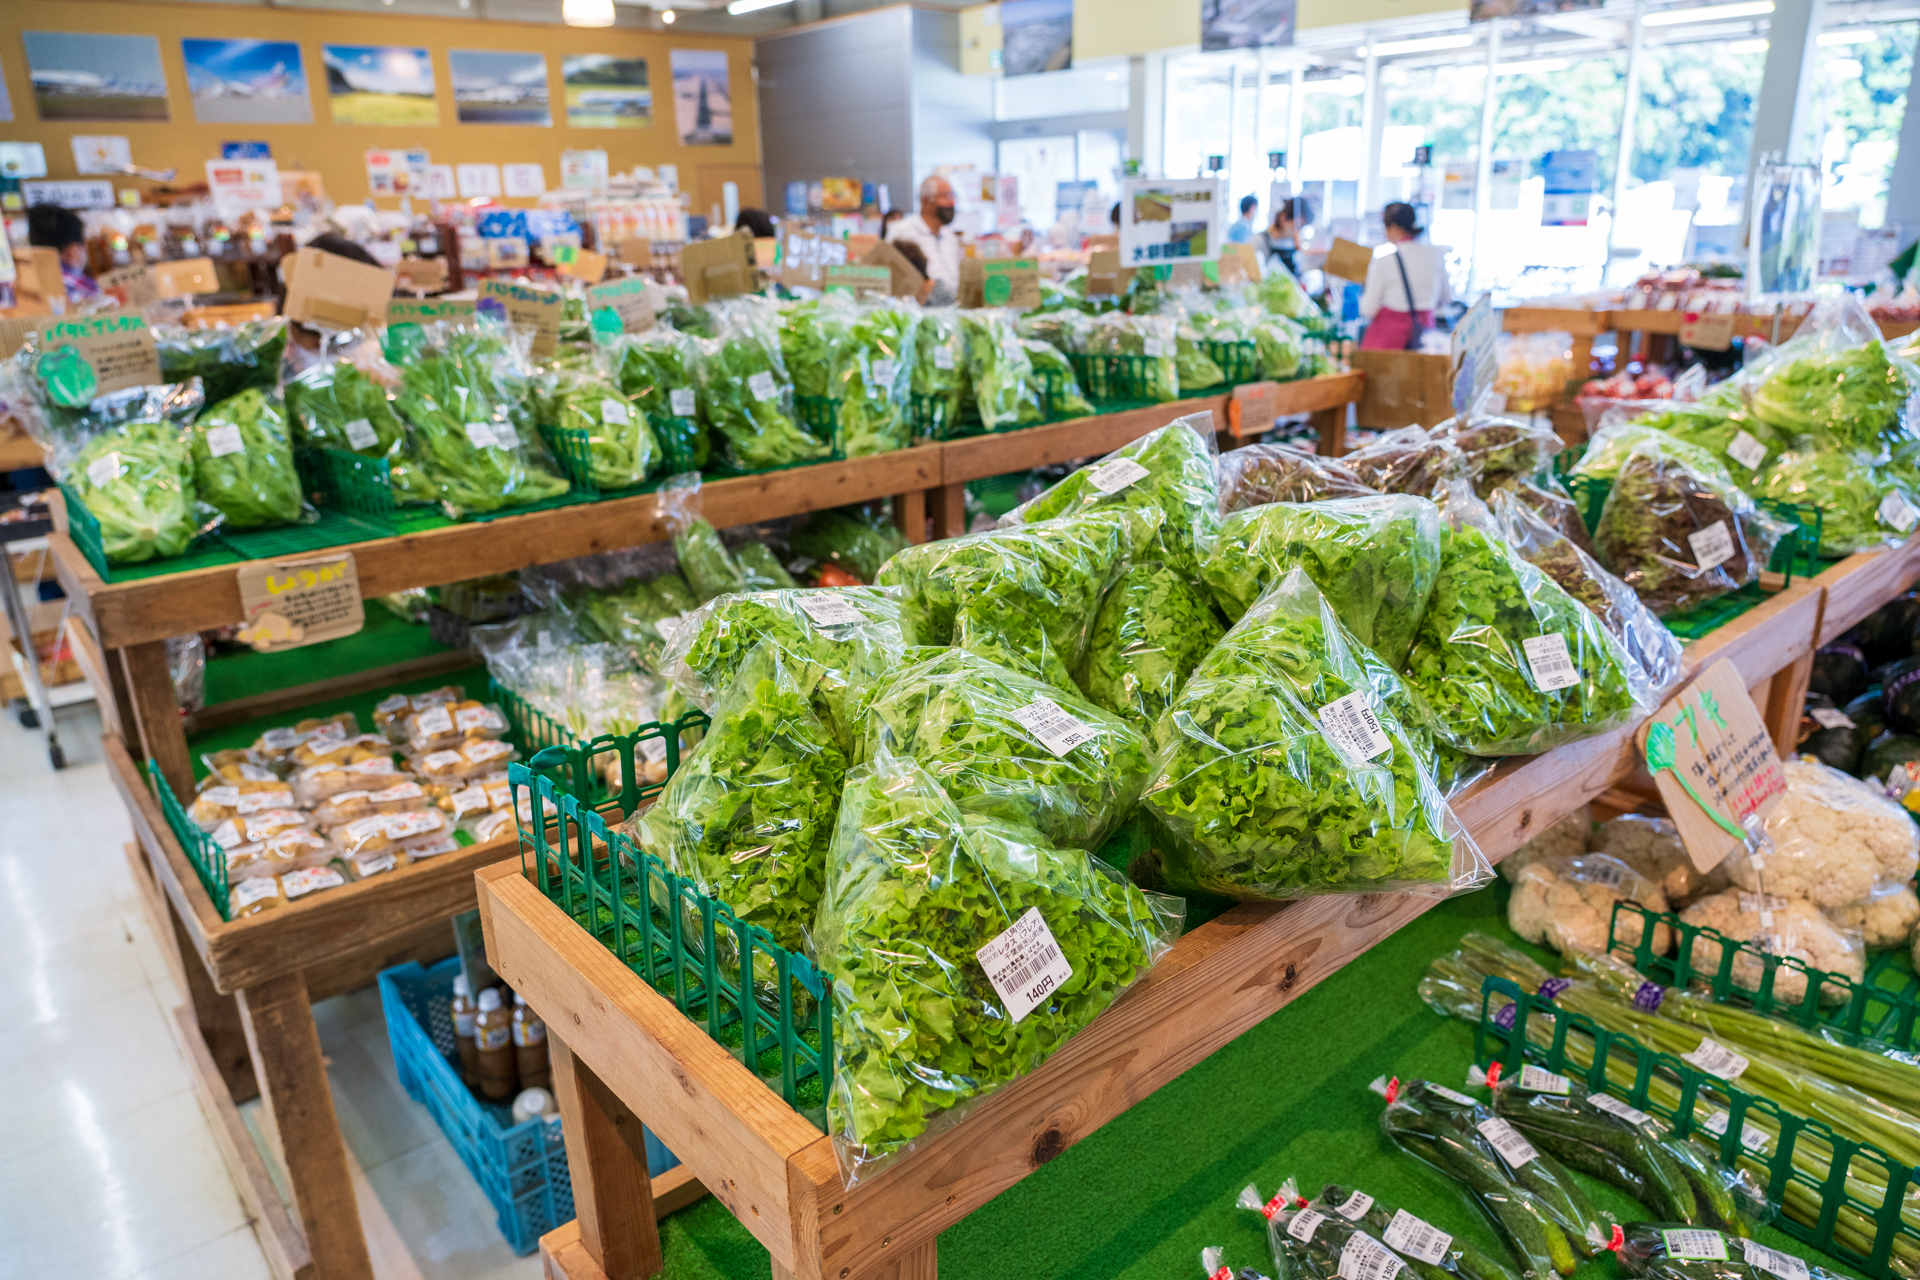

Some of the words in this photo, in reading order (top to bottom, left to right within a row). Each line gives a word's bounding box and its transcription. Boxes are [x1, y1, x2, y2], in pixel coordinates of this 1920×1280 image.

[1360, 708, 1380, 735] 150円
[1672, 689, 1728, 748] フキ
[1003, 925, 1045, 961] 千葉県芝山町産
[1025, 974, 1055, 1003] 140円
[1382, 1258, 1400, 1280] 130円
